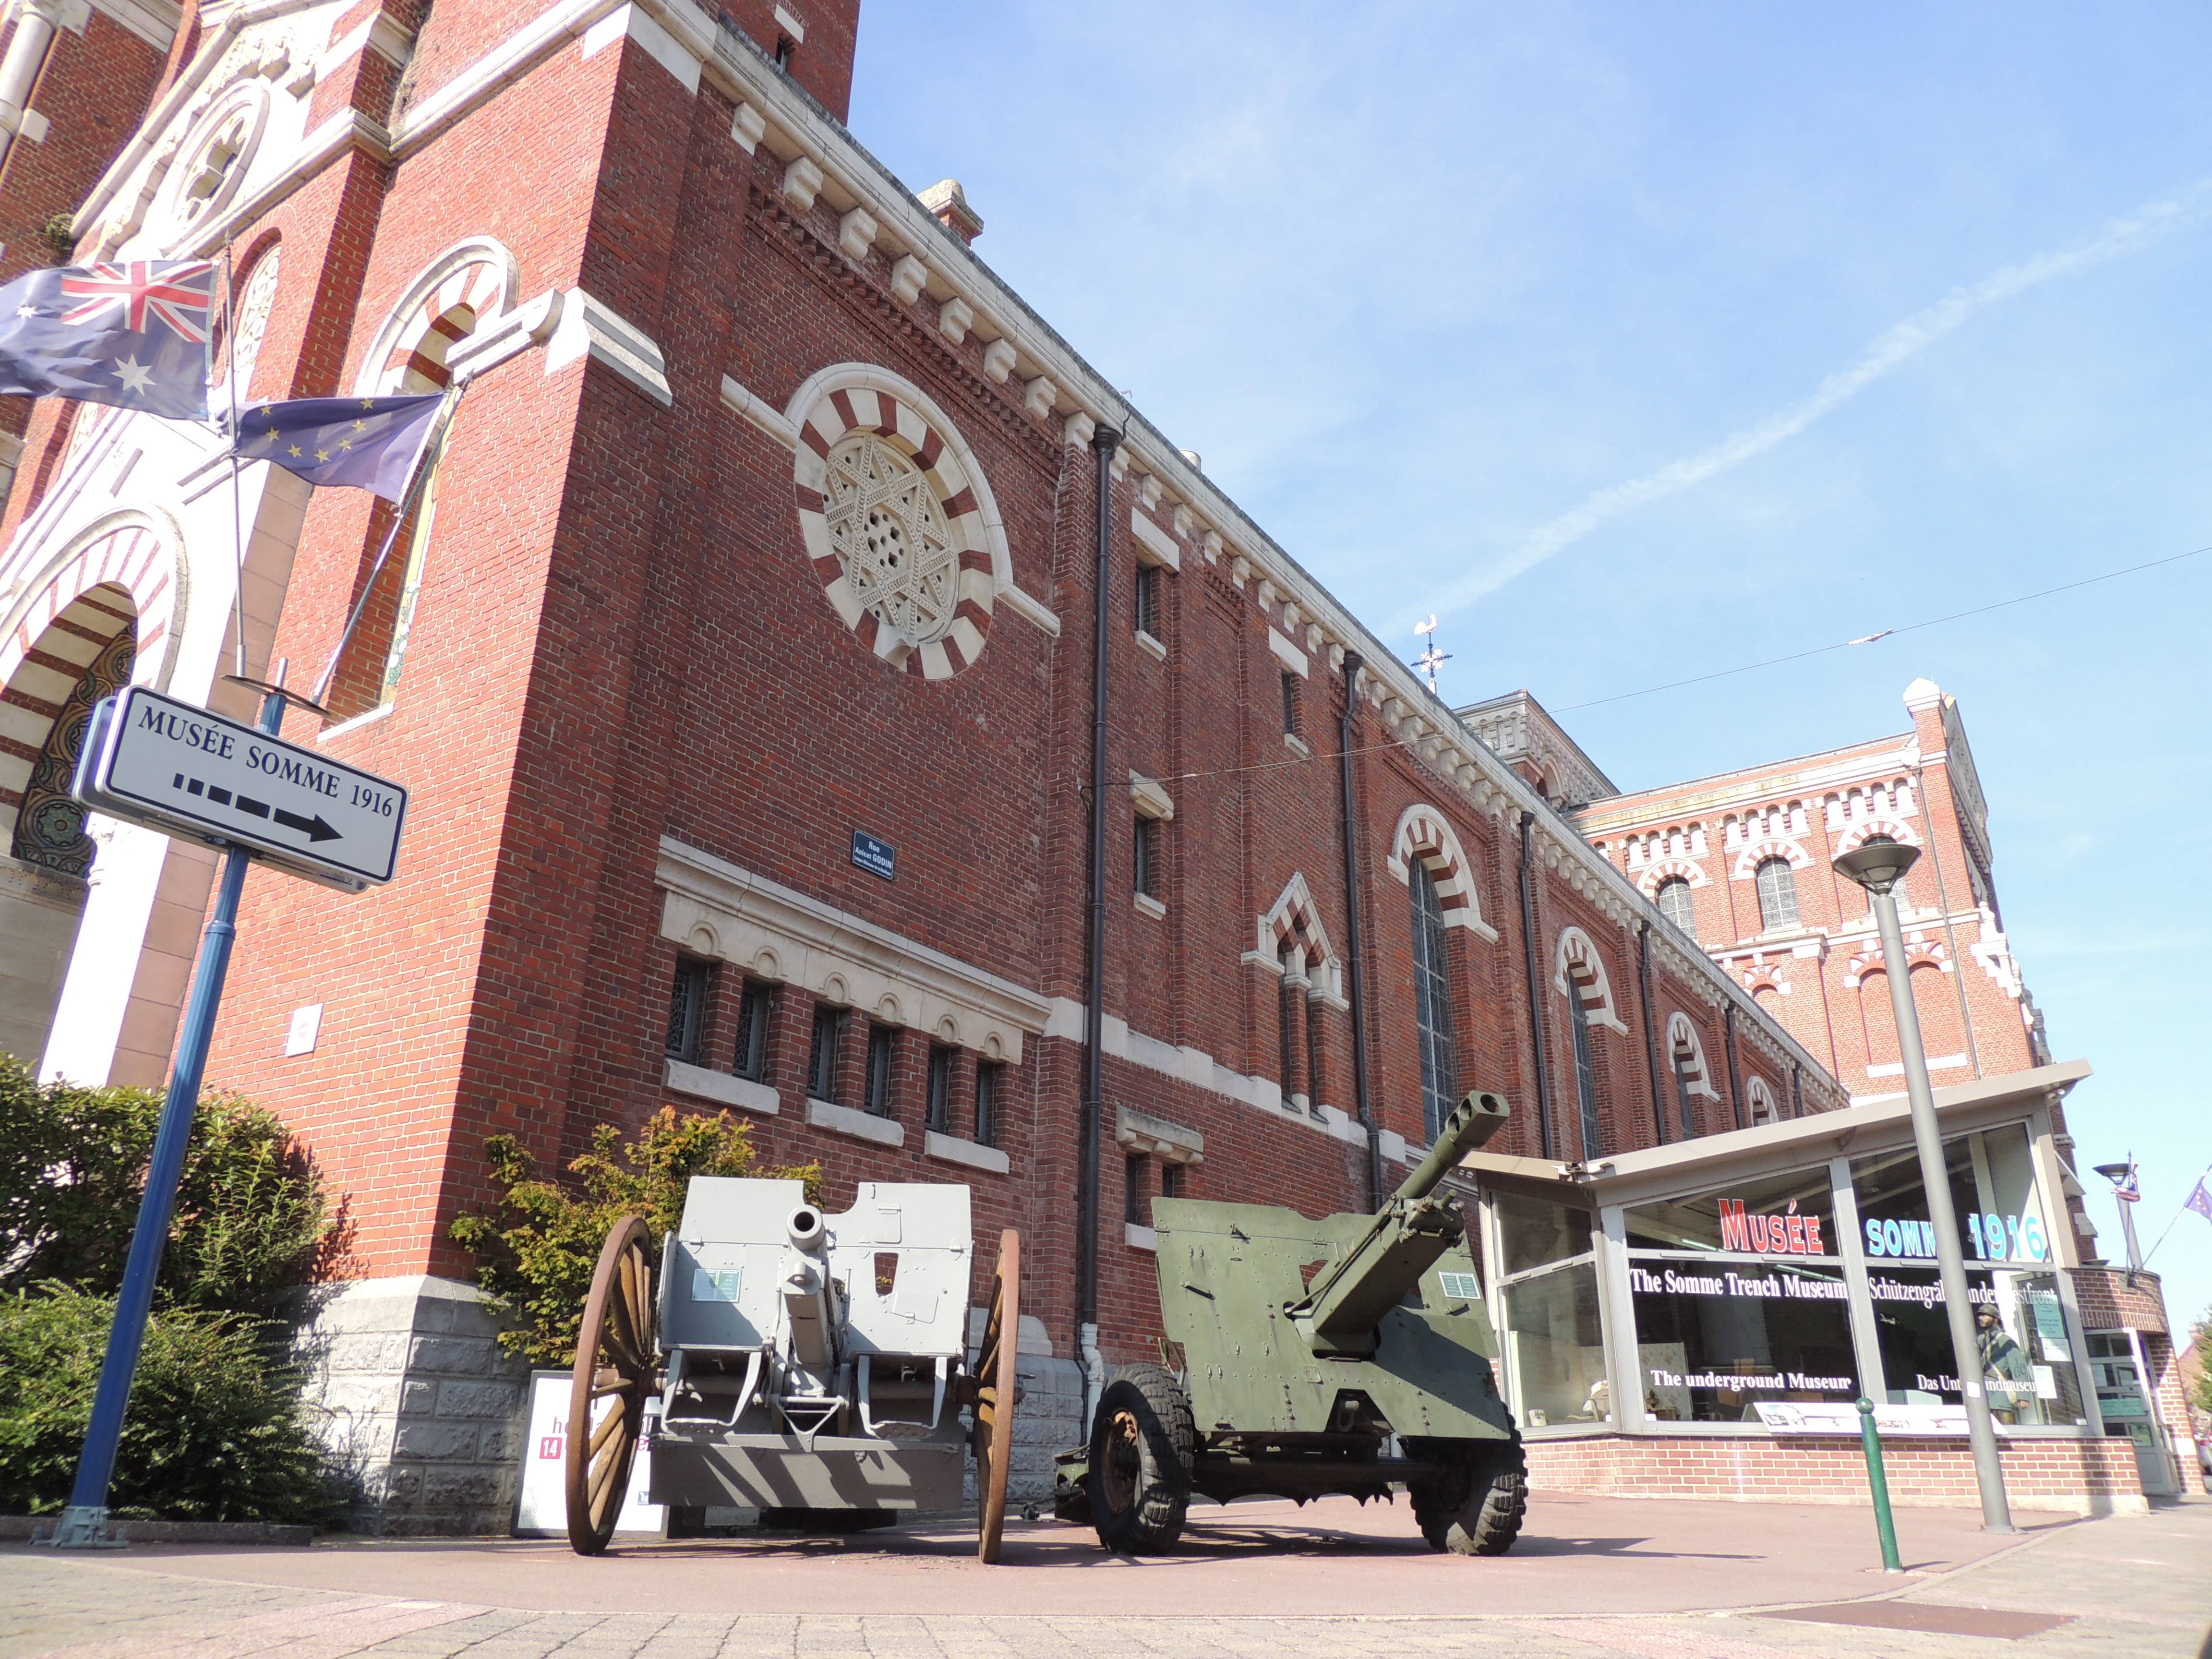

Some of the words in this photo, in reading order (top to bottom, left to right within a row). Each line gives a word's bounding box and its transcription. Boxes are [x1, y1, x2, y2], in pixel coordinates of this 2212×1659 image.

[138, 706, 235, 760] MUSÉE
[246, 746, 340, 798] SOMME
[350, 784, 393, 817] 1916
[855, 846, 872, 860] Anicet
[873, 854, 892, 869] GODIN
[868, 841, 880, 853] Rue
[1866, 1218, 1936, 1257] SOMM
[1968, 1213, 2045, 1261] 1916
[1629, 1269, 1662, 1293] The
[1665, 1269, 1723, 1295] Somme
[1725, 1273, 1781, 1297] Trench
[1782, 1274, 1849, 1299] Museum
[1650, 1370, 1681, 1387] The
[1685, 1371, 1785, 1391] underground
[1787, 1372, 1852, 1389] Museum
[1916, 1374, 1939, 1391] Das
[542, 1439, 558, 1457] 14
